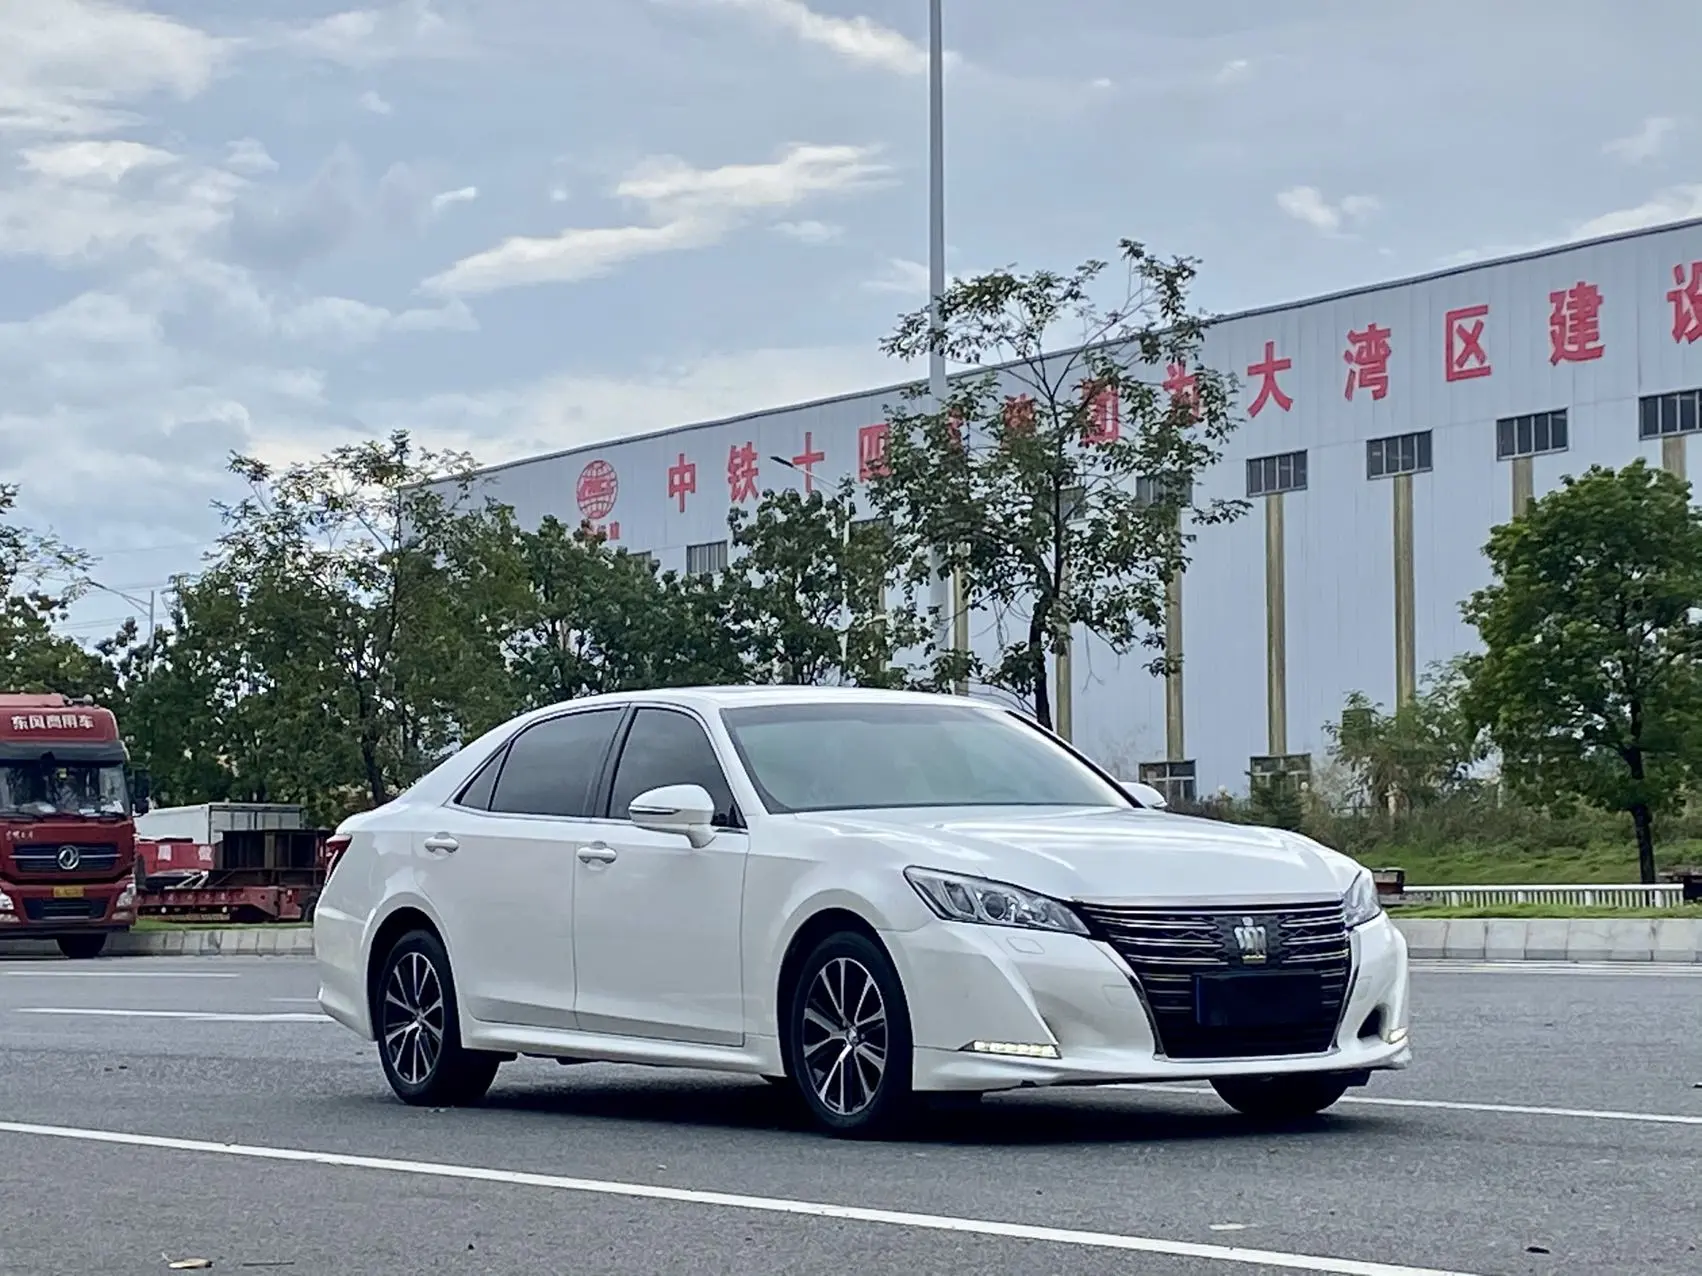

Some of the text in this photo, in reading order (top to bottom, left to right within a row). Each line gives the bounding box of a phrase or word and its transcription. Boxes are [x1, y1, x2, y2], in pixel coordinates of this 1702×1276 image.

[11, 714, 94, 730] 东风商用车
